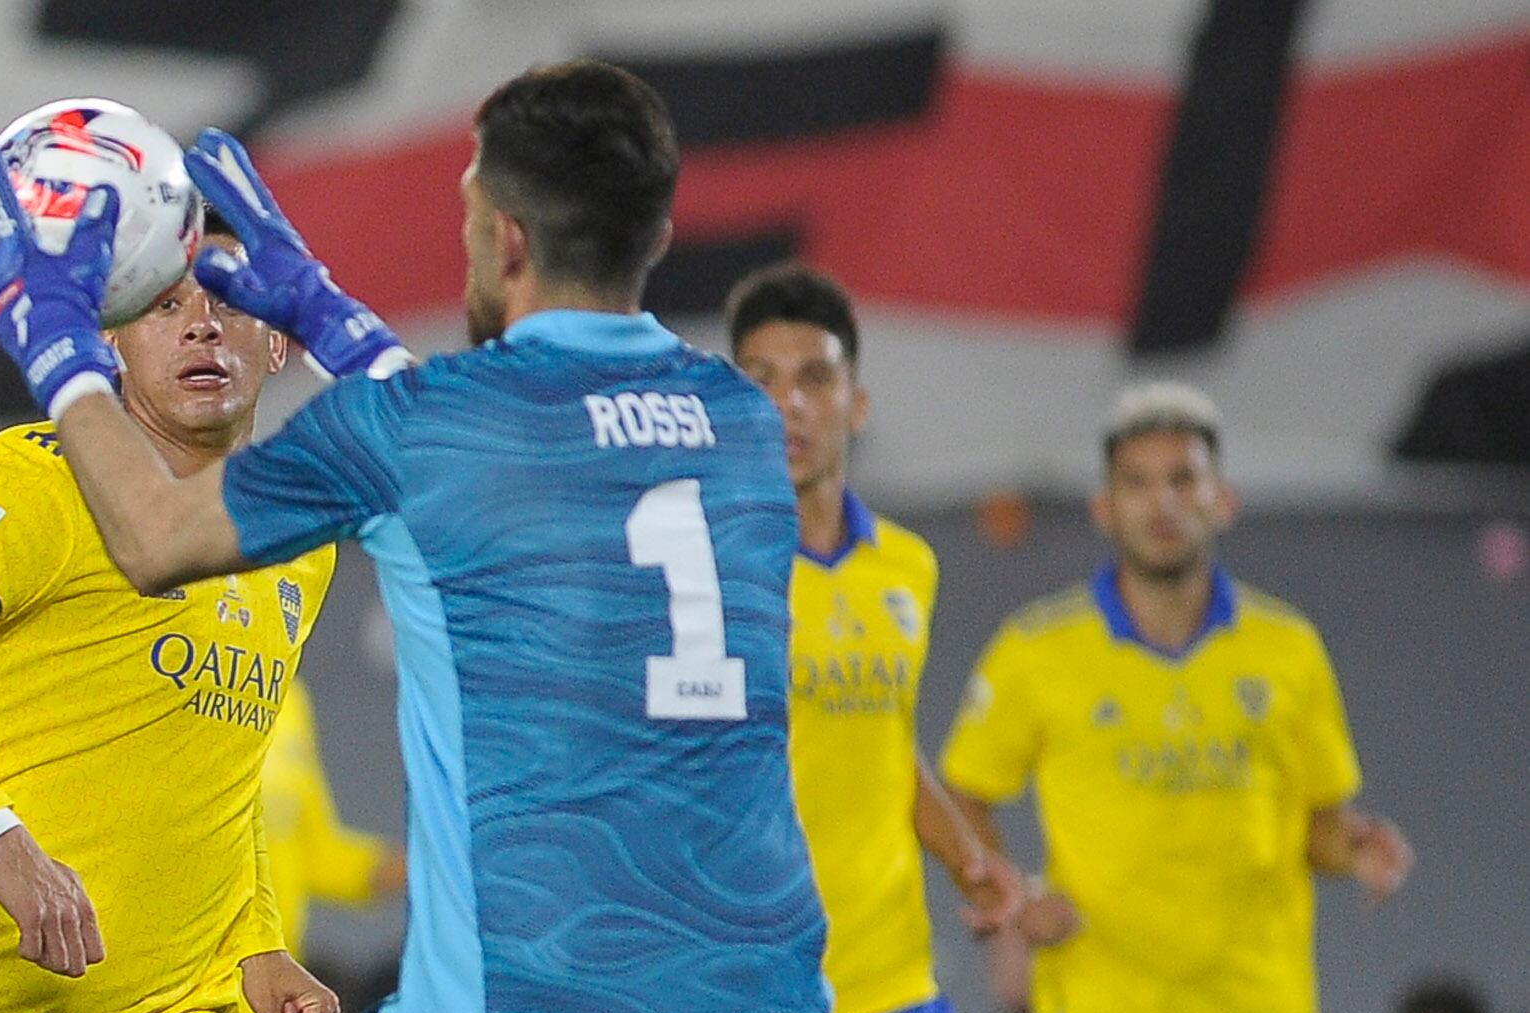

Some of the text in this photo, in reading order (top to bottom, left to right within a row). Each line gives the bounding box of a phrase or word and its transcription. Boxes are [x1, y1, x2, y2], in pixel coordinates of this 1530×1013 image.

[583, 393, 716, 448] ROSSI
[625, 478, 747, 720] 1
[150, 632, 286, 705] QATAR
